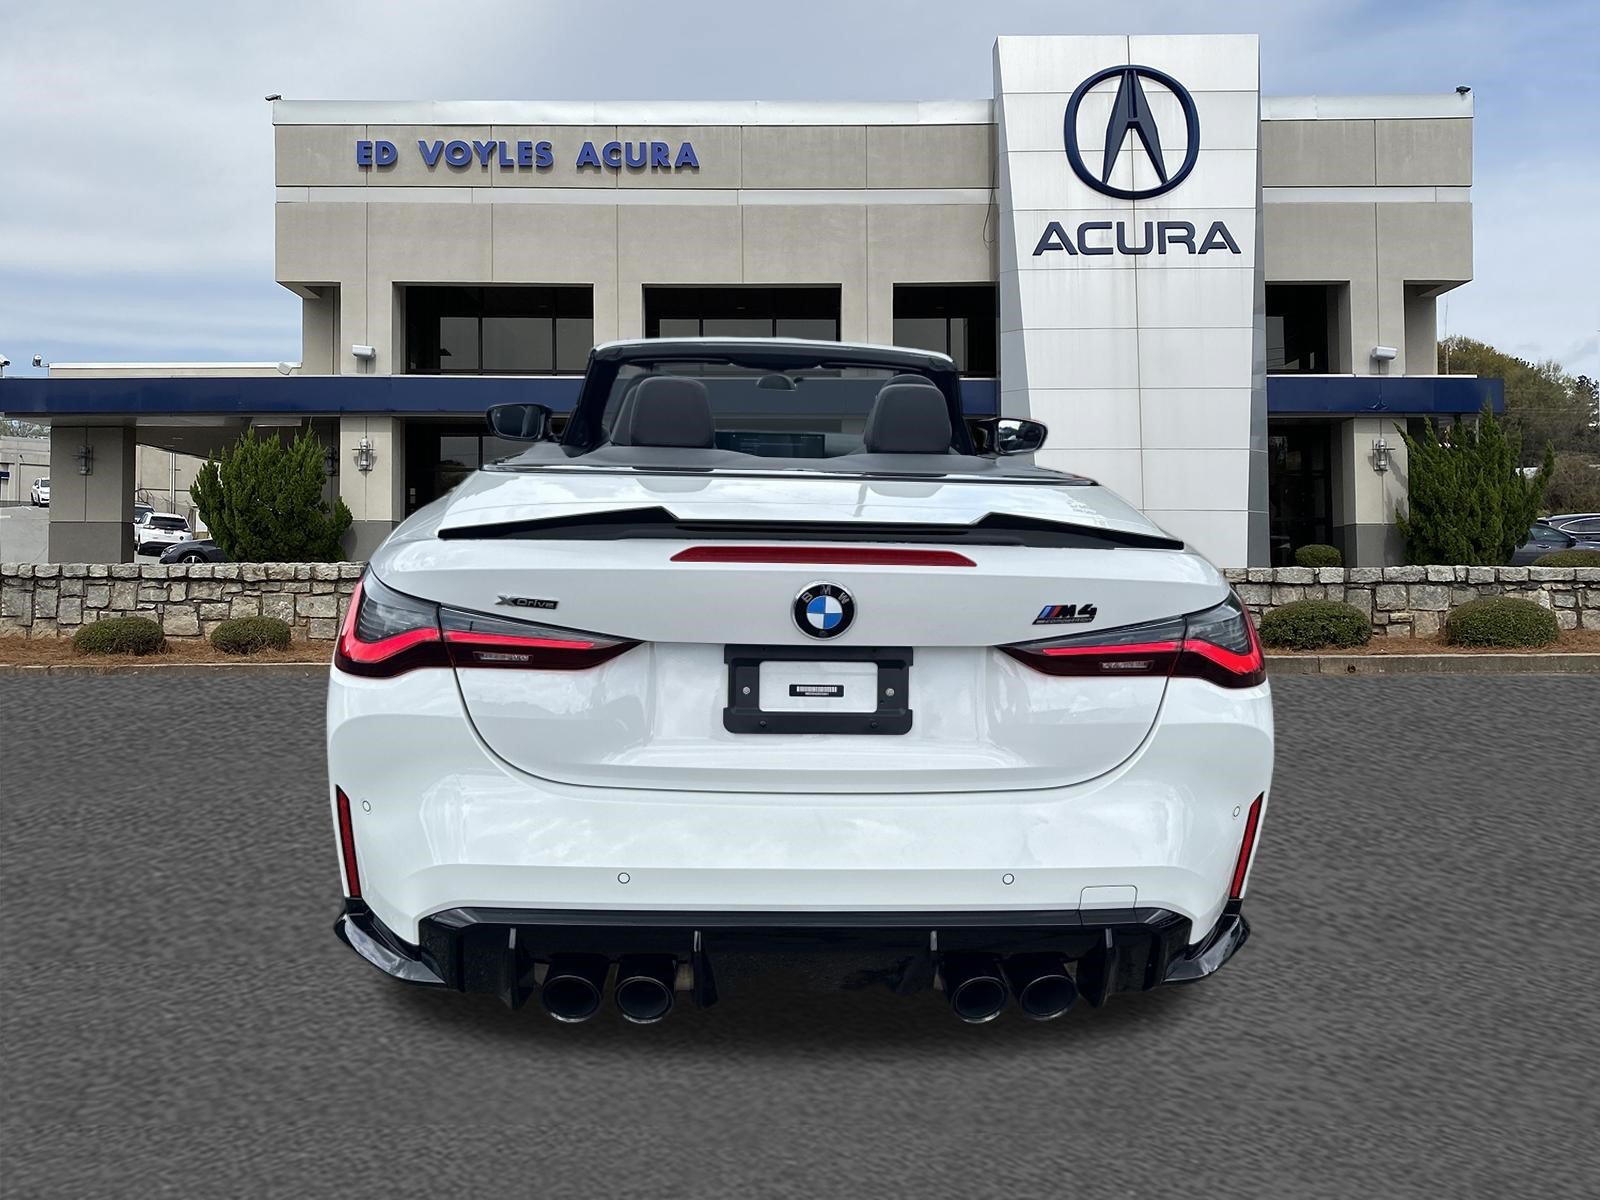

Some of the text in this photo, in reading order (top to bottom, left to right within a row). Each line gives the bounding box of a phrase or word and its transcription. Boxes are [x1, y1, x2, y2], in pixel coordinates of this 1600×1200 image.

[356, 139, 700, 171] ED VOYLES ACURA
[1032, 221, 1242, 256] ACURA
